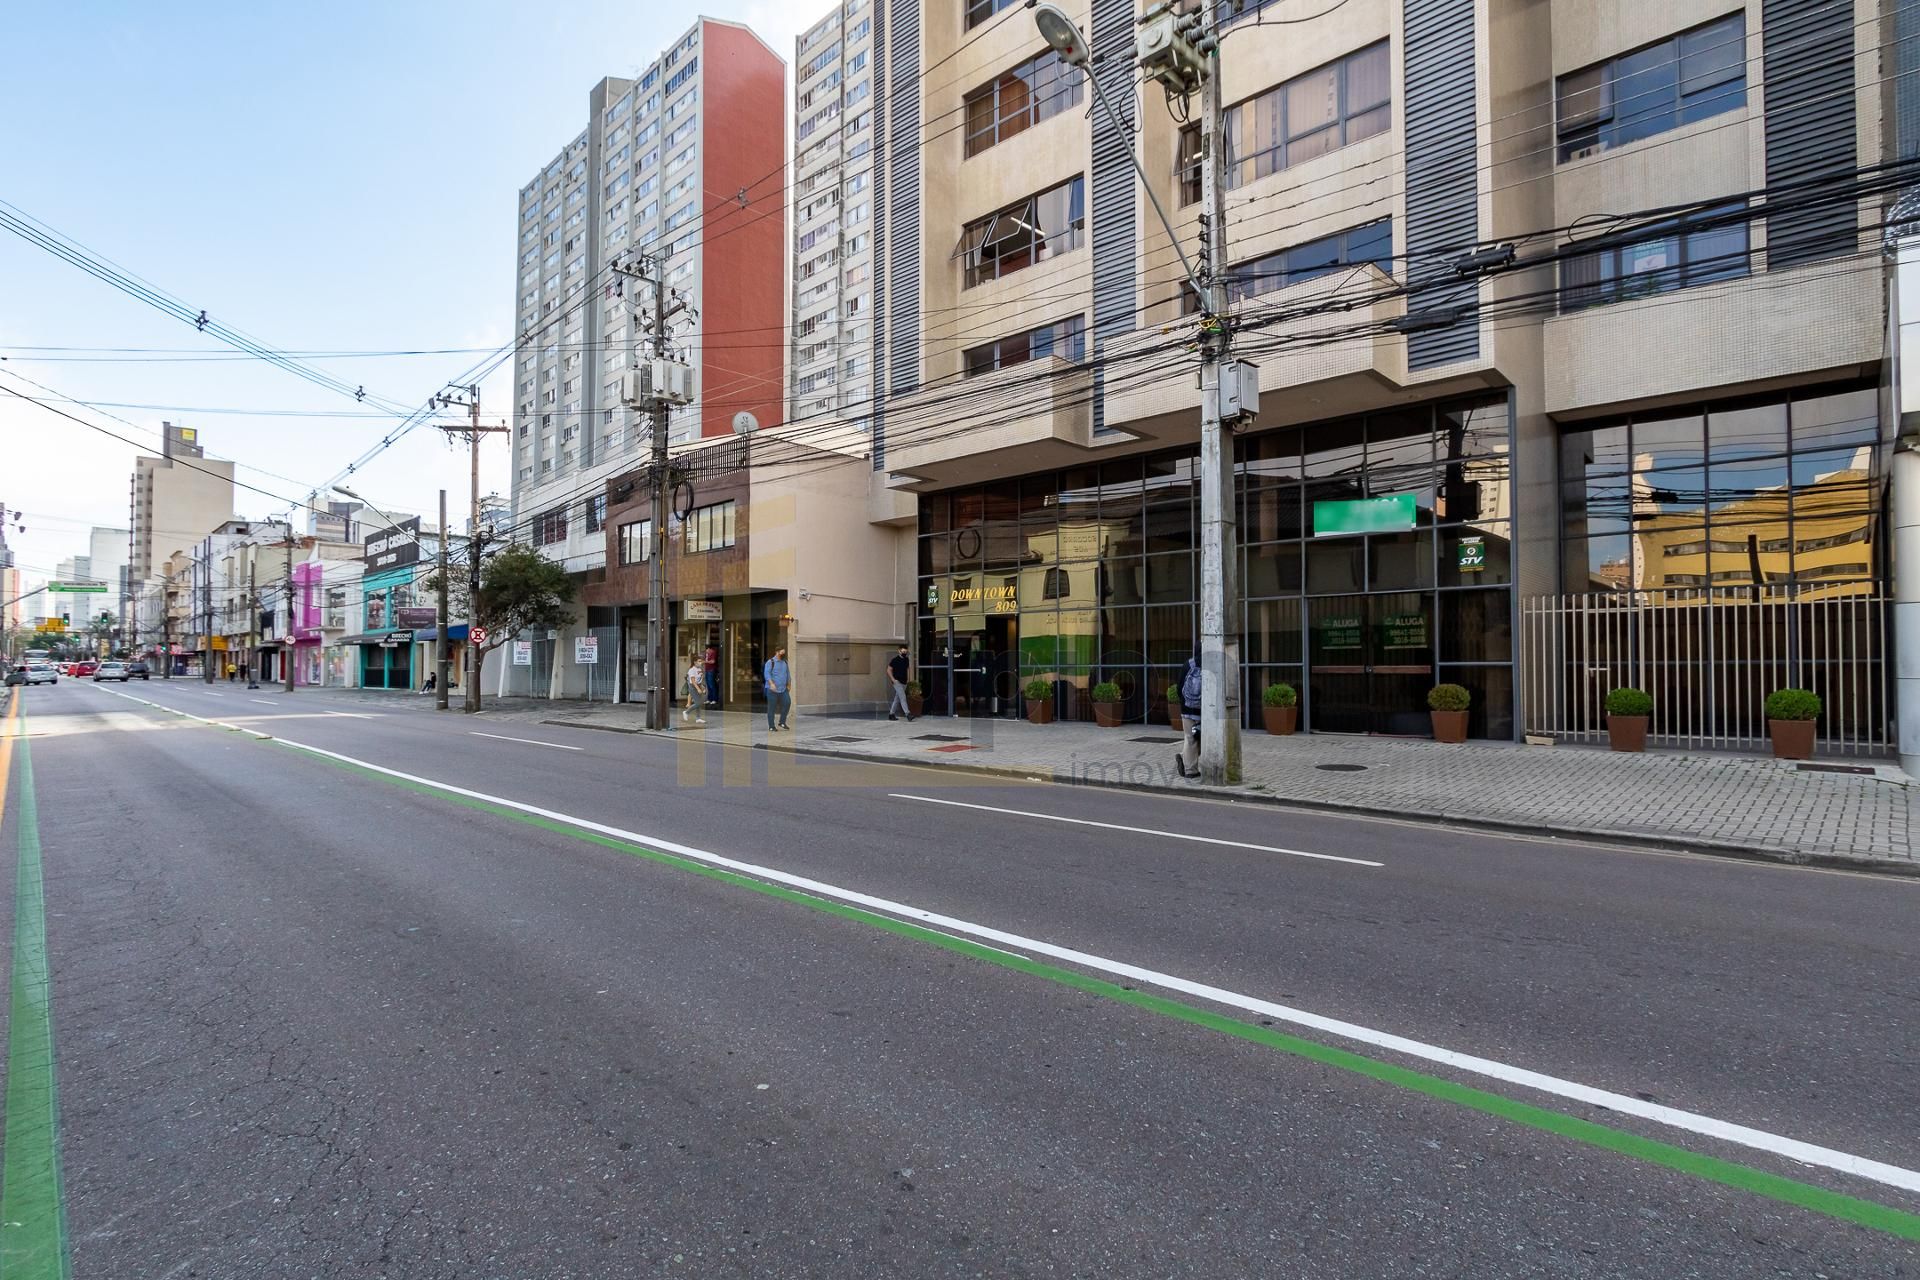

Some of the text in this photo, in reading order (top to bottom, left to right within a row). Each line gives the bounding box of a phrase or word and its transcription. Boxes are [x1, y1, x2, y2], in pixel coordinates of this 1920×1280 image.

[1460, 556, 1483, 565] STV
[950, 585, 1016, 601] DOWNTOWN
[994, 600, 1017, 613] 809
[1332, 619, 1359, 628] ALUGA
[1395, 616, 1425, 626] ALUGA
